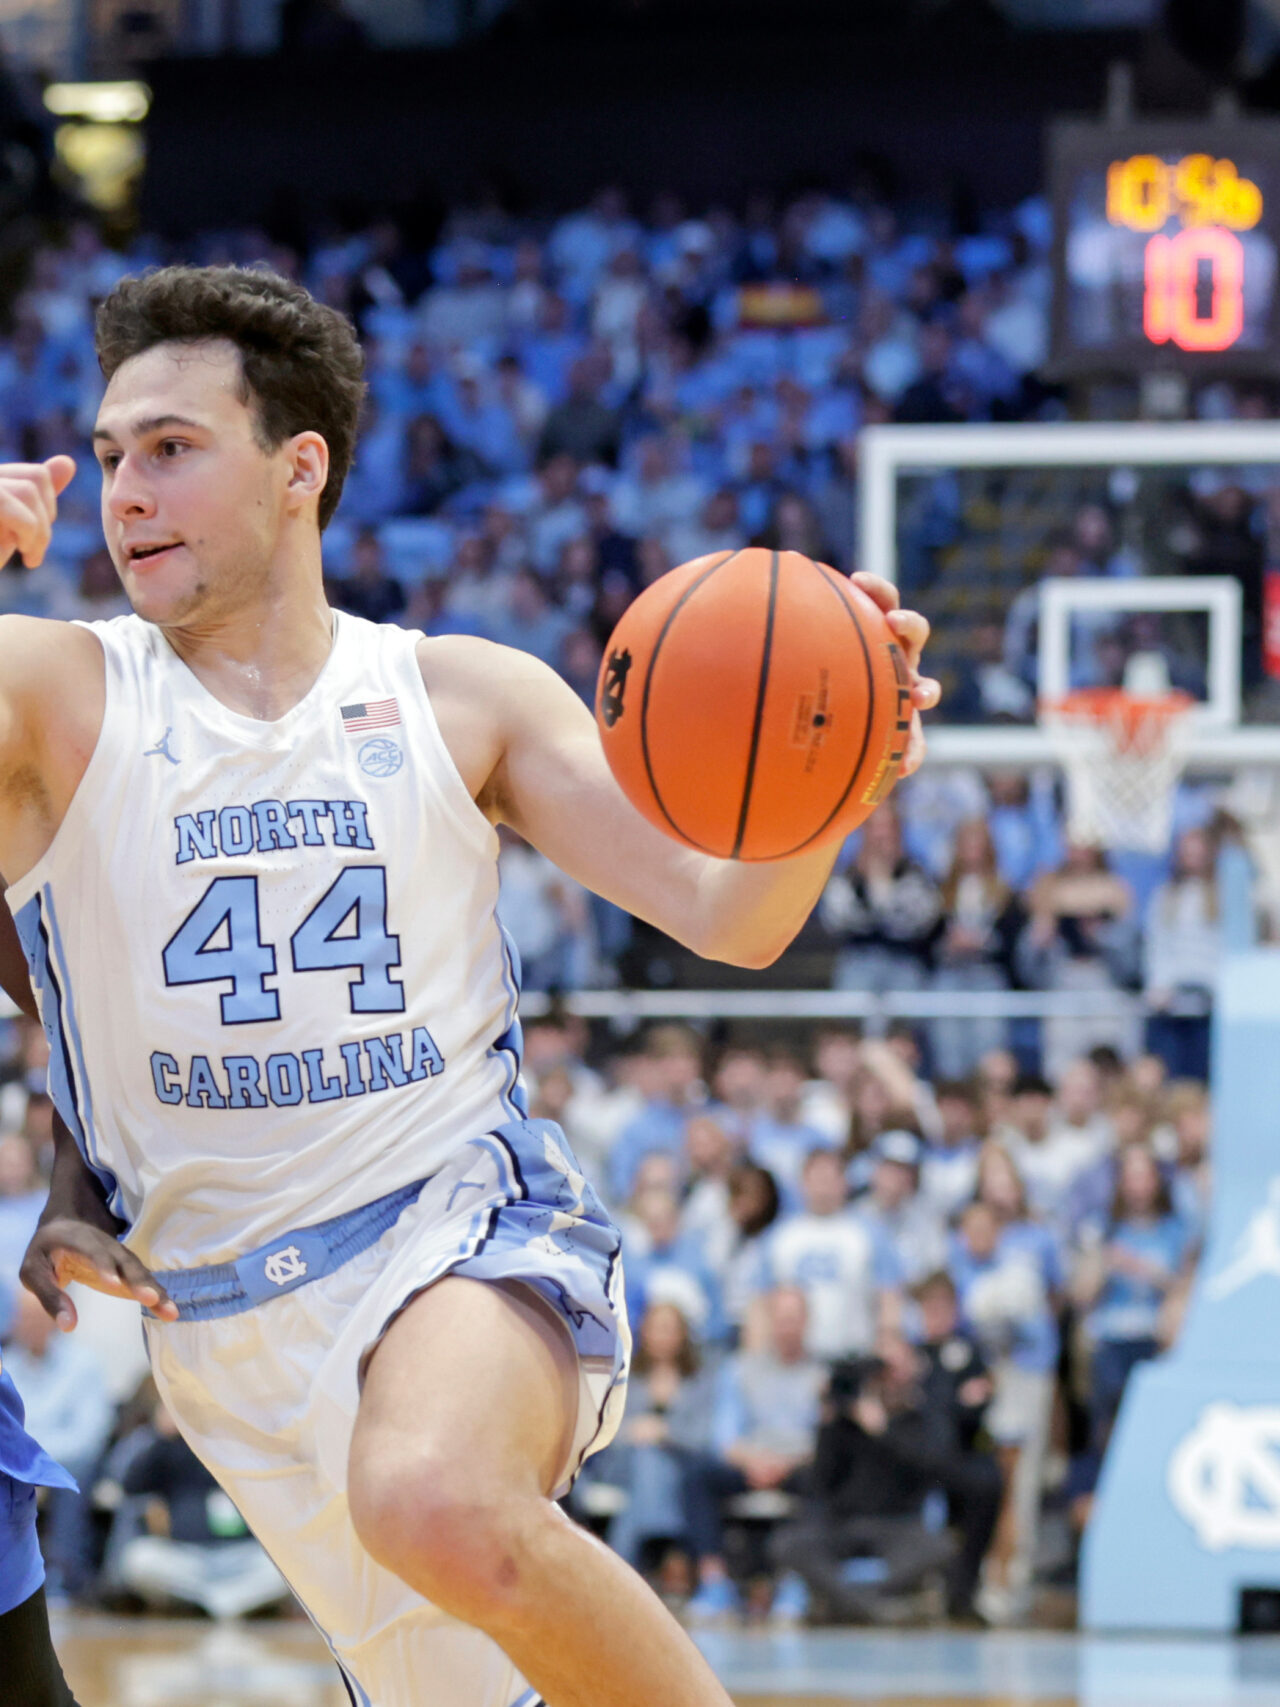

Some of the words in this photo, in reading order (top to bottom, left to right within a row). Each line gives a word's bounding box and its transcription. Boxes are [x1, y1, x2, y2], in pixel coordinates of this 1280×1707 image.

[1142, 226, 1244, 352] 10
[174, 799, 376, 865] NORTH
[161, 865, 406, 1026] 44
[150, 1025, 446, 1110] CAROLINA
